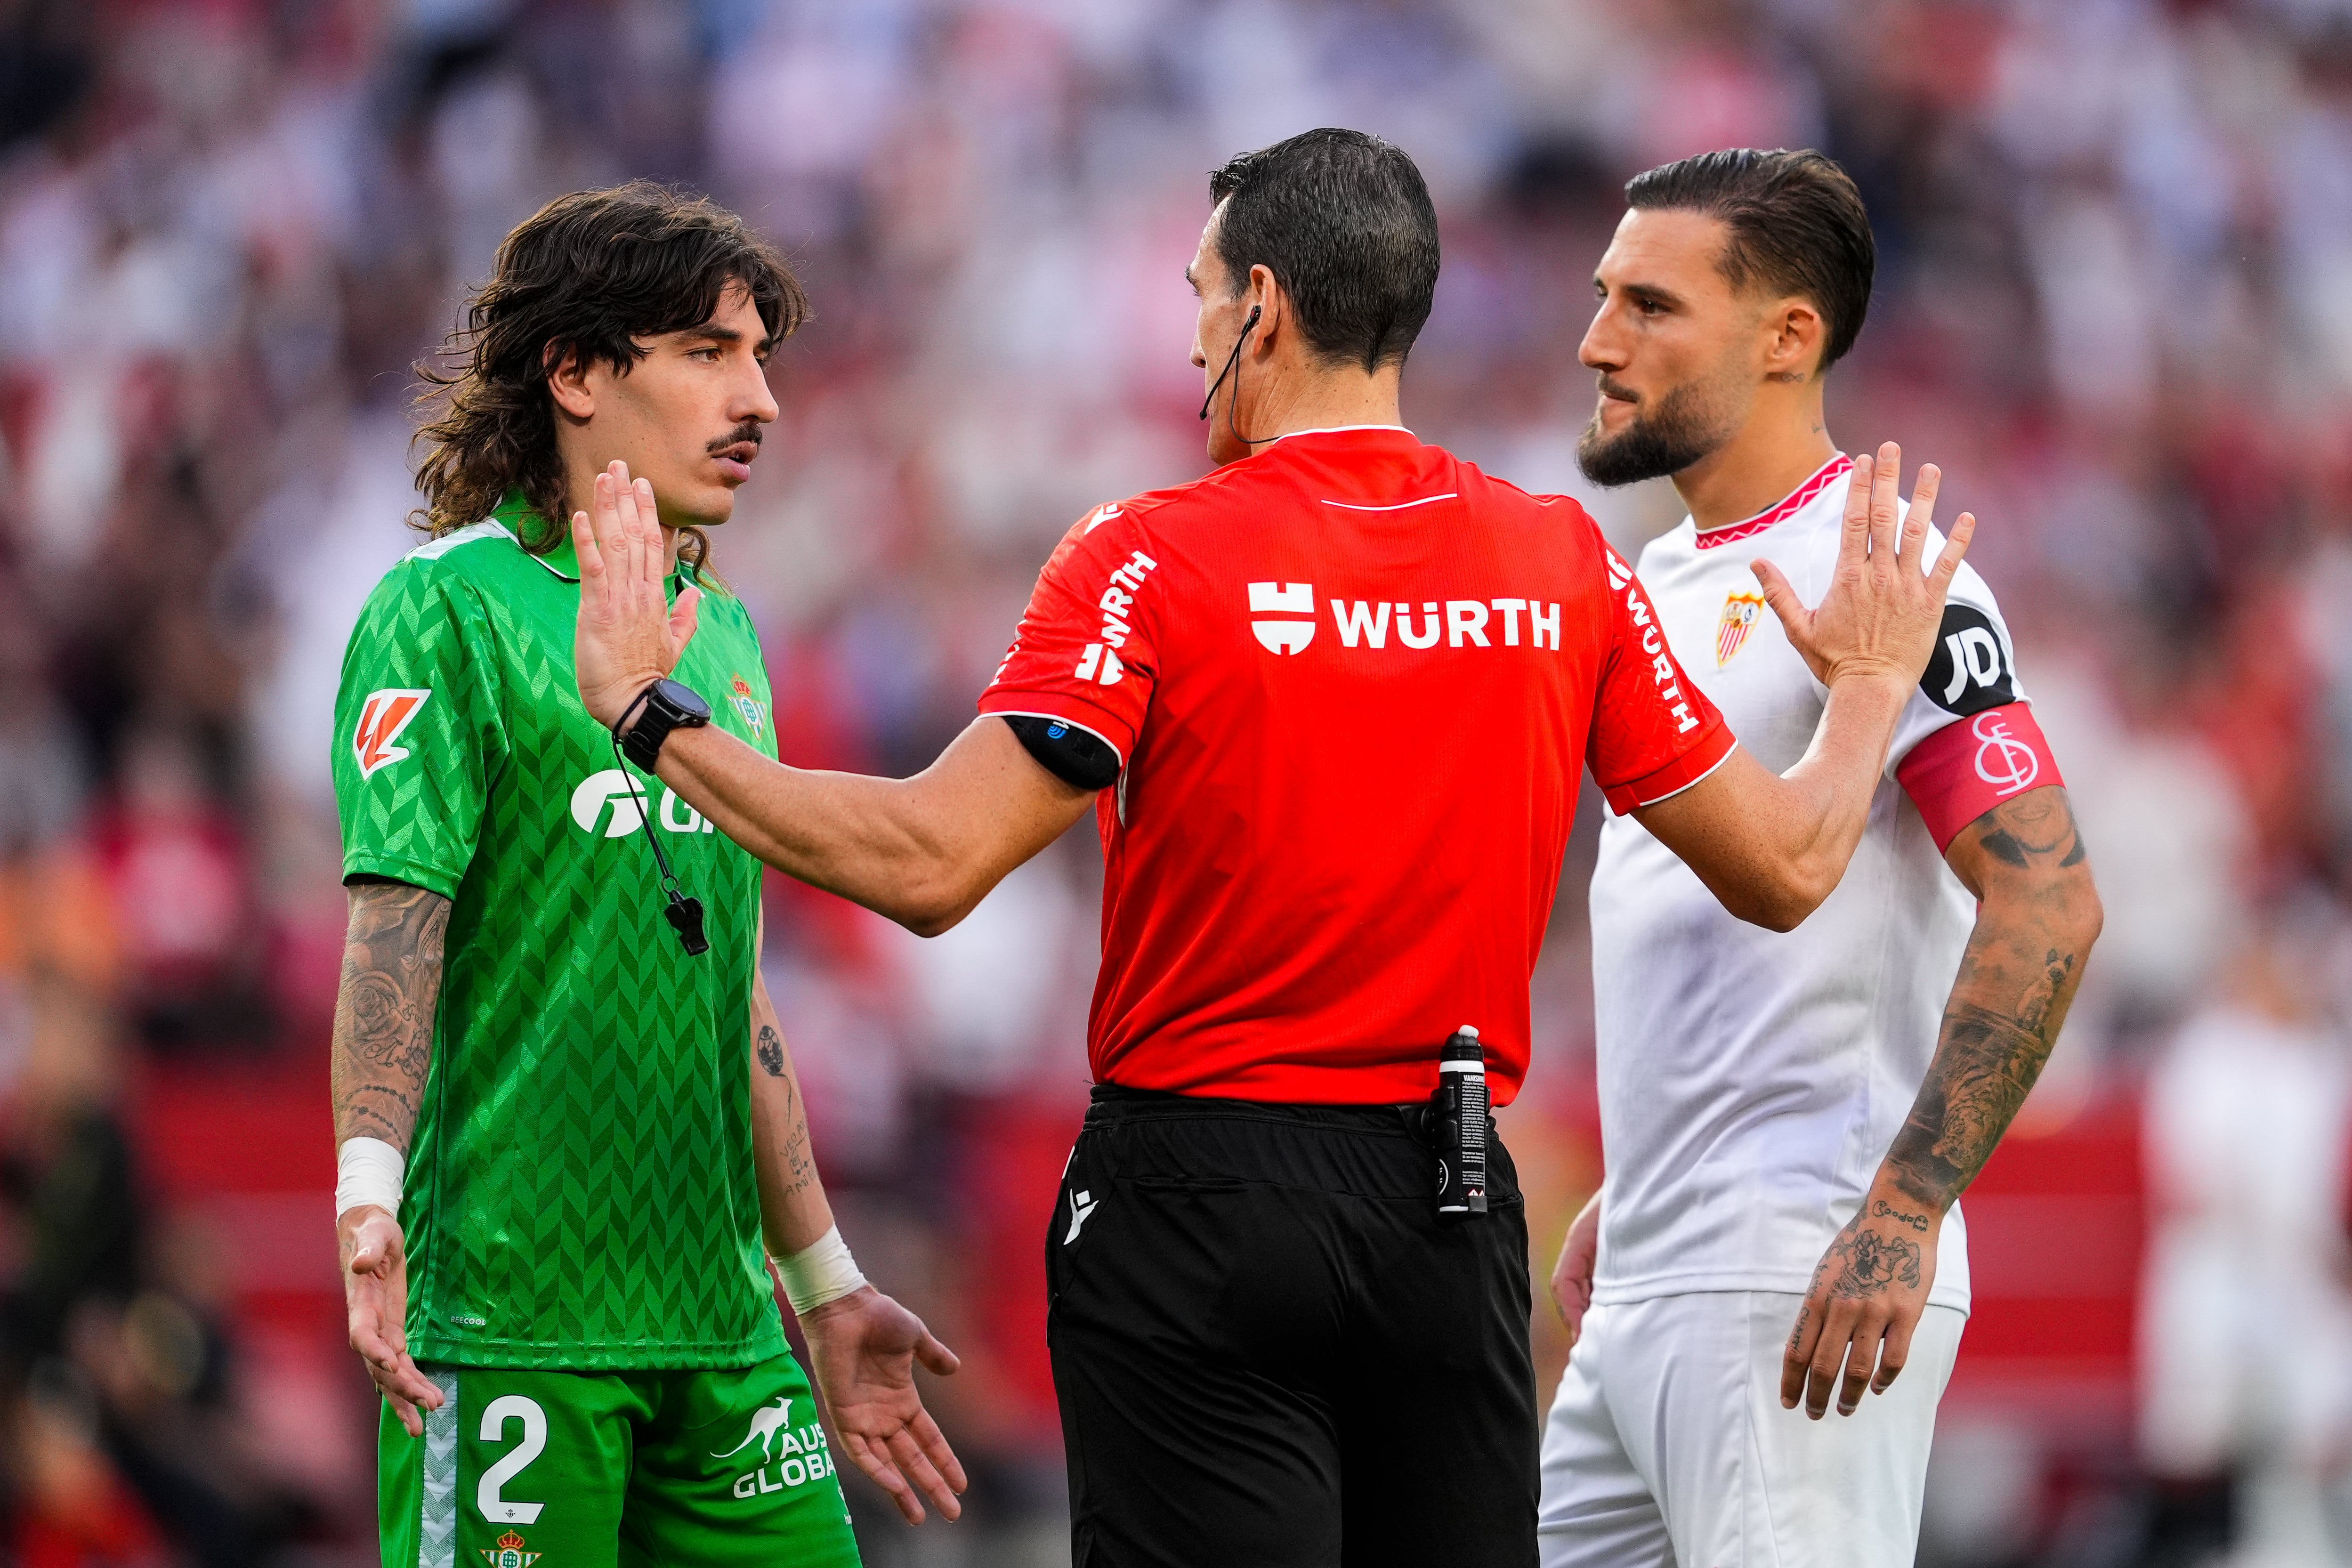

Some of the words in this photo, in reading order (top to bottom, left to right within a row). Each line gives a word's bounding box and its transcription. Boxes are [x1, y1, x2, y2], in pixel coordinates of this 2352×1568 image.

[1330, 598, 1560, 651] WÜRTH
[1627, 588, 1699, 734] WÜRTH
[1944, 627, 2001, 705] JD
[451, 1316, 486, 1326] BEECOOL
[477, 1394, 547, 1525] 2
